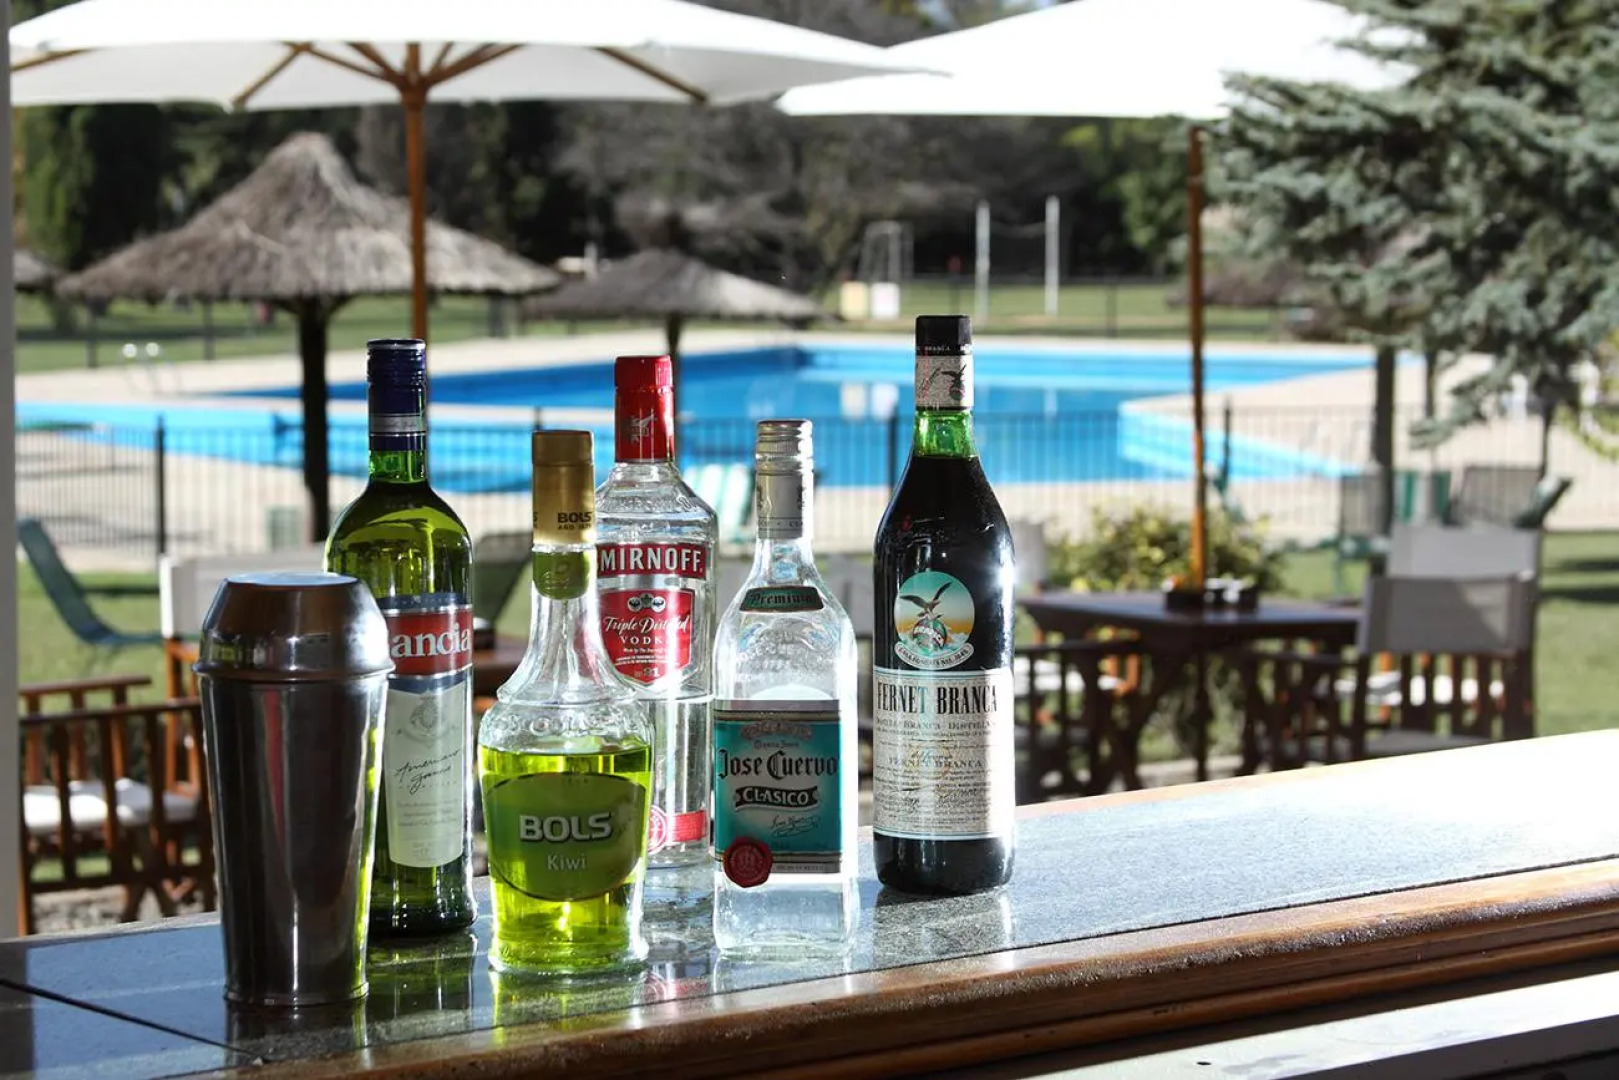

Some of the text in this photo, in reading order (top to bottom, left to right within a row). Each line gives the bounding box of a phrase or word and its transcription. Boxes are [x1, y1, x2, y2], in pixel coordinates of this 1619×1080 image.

[557, 511, 592, 523] BOLS
[597, 547, 701, 572] MIRNOFF
[602, 616, 637, 635] Triple
[390, 621, 471, 658] ancia
[620, 636, 665, 645] VODK
[877, 682, 997, 715] FERNET BRANCA
[718, 748, 839, 780] Jose Cuervo
[742, 786, 809, 806] CLASICO
[520, 811, 613, 842] BOLS
[547, 853, 586, 871] Kiwi
